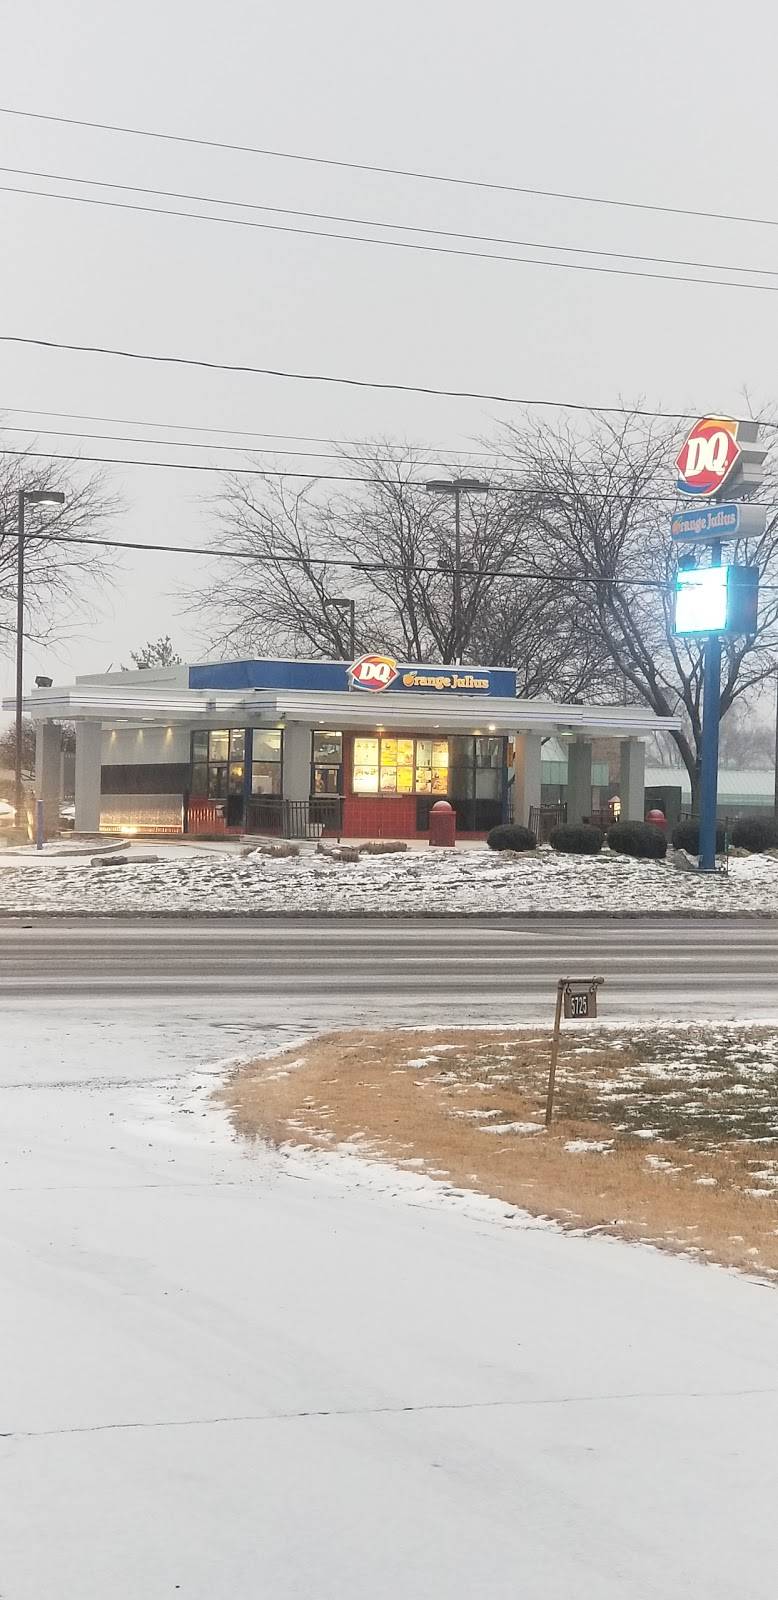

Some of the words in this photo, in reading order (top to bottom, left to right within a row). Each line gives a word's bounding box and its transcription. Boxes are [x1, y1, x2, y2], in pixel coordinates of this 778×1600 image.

[685, 432, 729, 478] DQ
[672, 517, 706, 535] Orange
[707, 511, 736, 530] Julius
[359, 662, 391, 683] DQ
[403, 671, 451, 690] Orange
[451, 674, 489, 689] Julius
